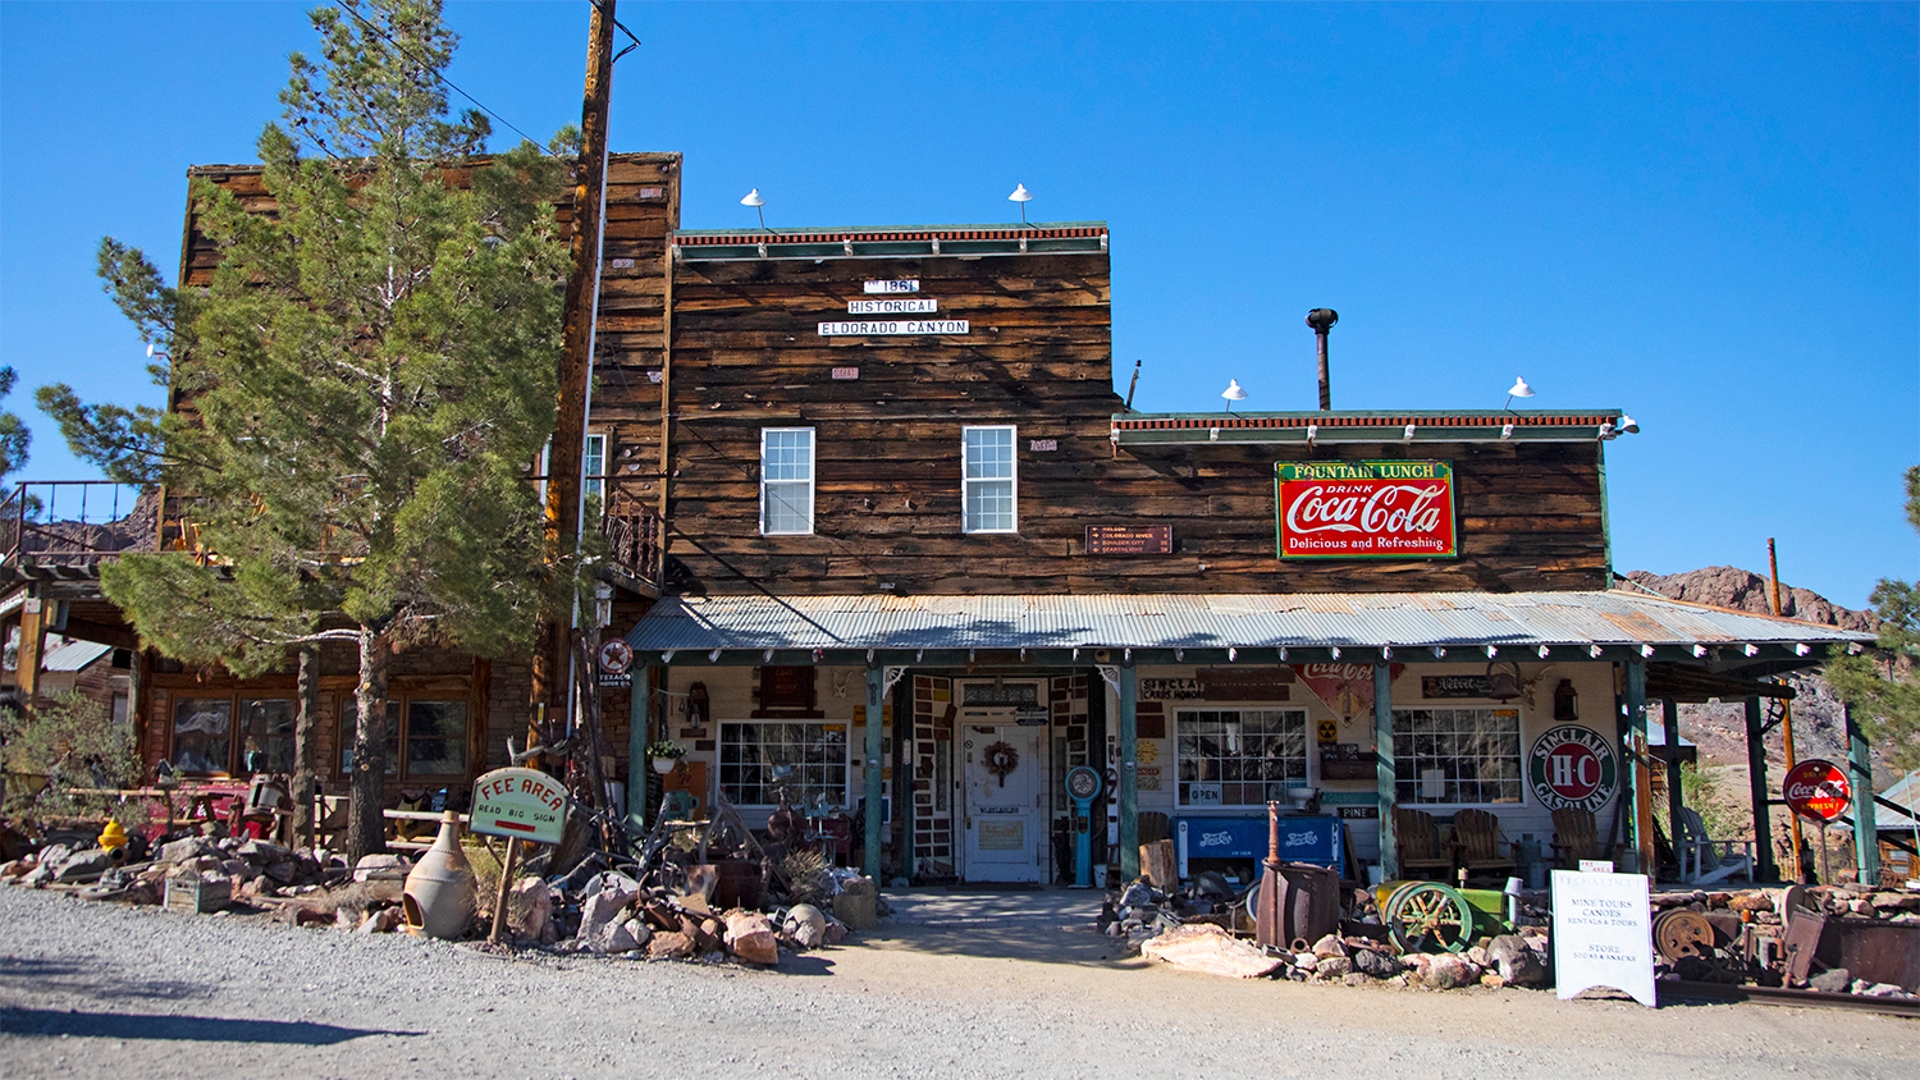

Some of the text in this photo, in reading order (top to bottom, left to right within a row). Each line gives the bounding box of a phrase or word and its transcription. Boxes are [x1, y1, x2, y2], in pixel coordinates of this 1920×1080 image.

[884, 280, 913, 291] 1861
[850, 300, 935, 313] HISTORICAL
[822, 321, 966, 334] ELDORADO CANYON
[1294, 464, 1434, 479] FOUNTAIN LUNCH
[1326, 485, 1373, 493] DRINK
[1286, 485, 1446, 534] Coca-Cola
[1289, 536, 1443, 551] Delicious and Refreshing
[1143, 679, 1200, 689] SINCLA
[1535, 728, 1610, 760] SINCLAIR
[481, 777, 563, 811] FEE AREA
[1192, 790, 1218, 800] OPEN
[478, 804, 501, 814] READ
[533, 812, 556, 822] SIGN
[1343, 808, 1368, 818] PINE
[1571, 898, 1633, 908] MINE TOURS
[1582, 908, 1622, 918] CANOES
[1589, 944, 1621, 953] STORE
